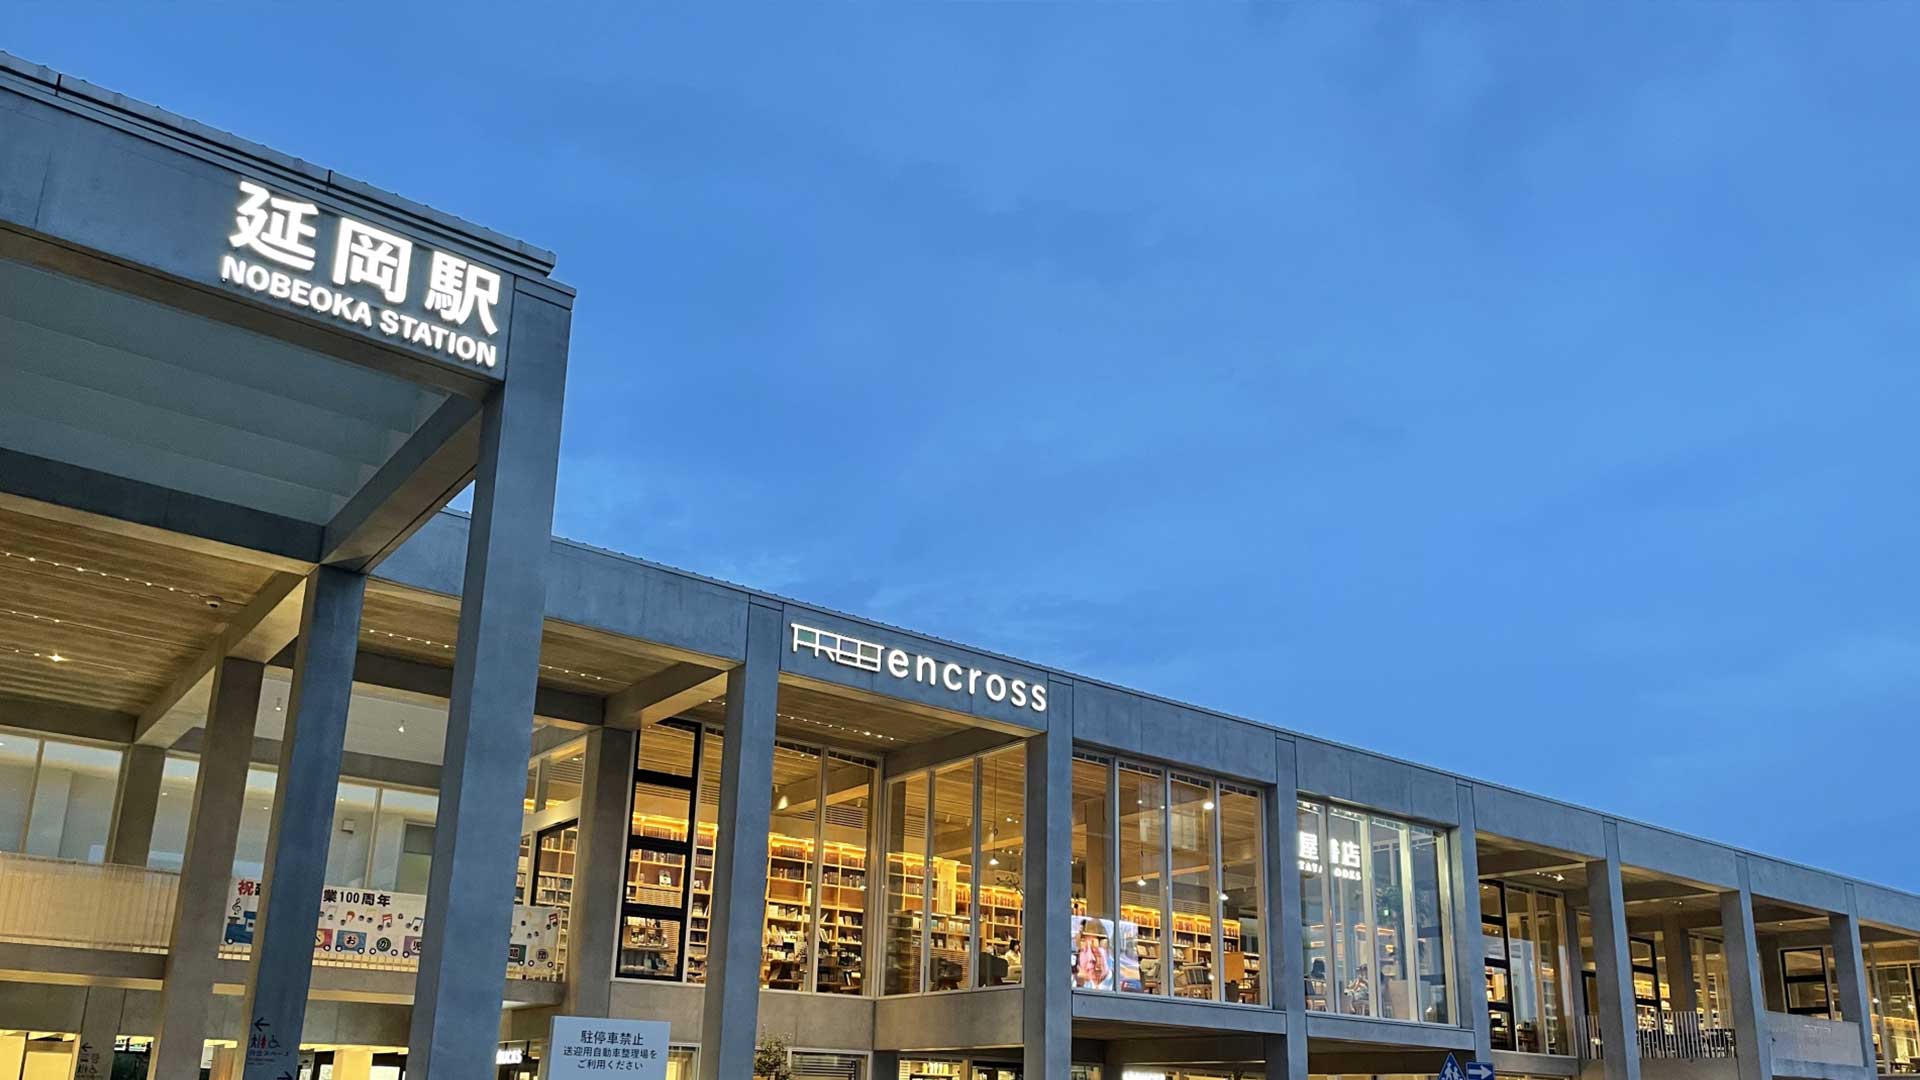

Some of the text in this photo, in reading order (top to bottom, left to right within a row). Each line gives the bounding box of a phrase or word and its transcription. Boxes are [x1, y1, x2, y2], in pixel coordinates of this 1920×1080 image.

[229, 180, 501, 336] 延岡駅
[221, 255, 497, 369] NOBEOKA STATION
[888, 649, 1047, 711] encross
[563, 1046, 657, 1059] 送迎用自動車整理場を
[580, 1030, 644, 1045] 駐停車禁止
[577, 1060, 643, 1070] ご利用ください
